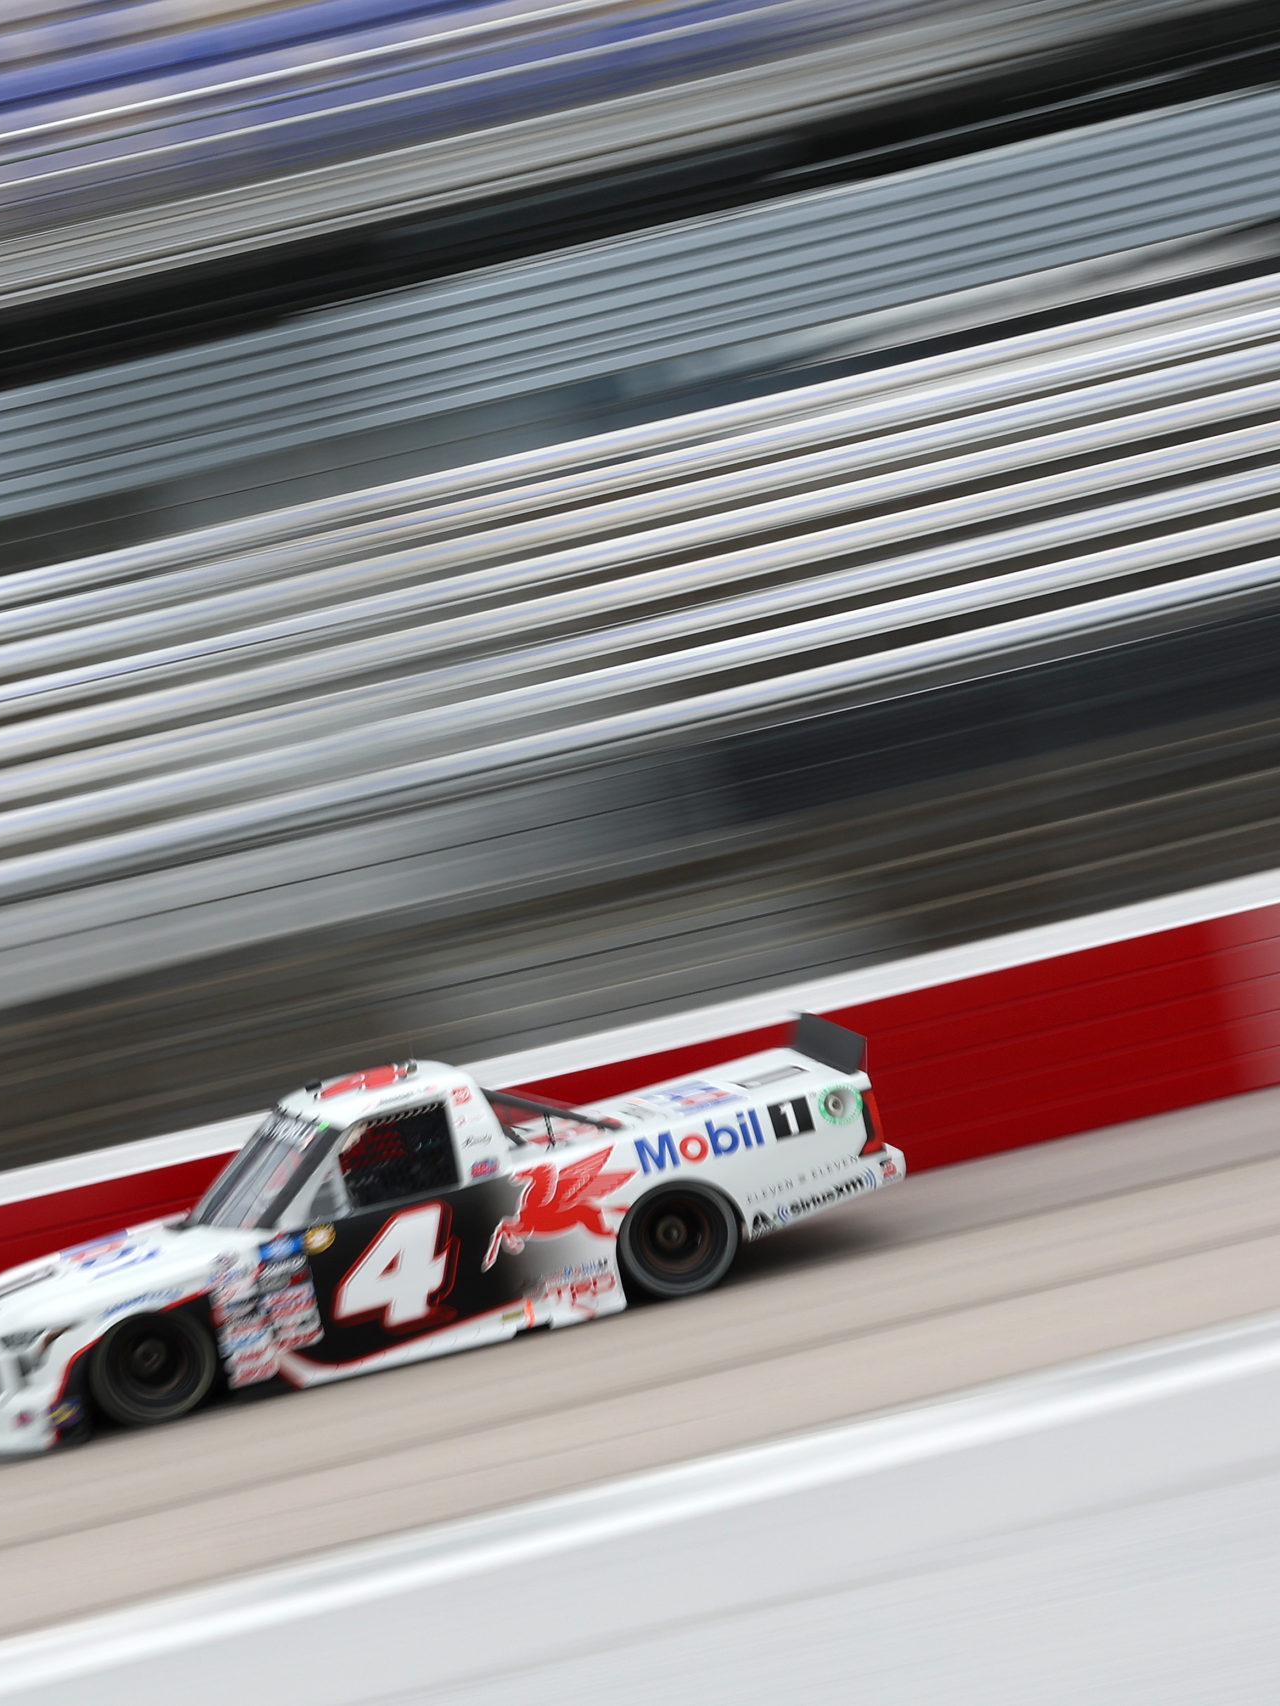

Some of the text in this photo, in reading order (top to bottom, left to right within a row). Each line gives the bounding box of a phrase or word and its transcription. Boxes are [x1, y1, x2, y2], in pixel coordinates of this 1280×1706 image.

[633, 1108, 765, 1176] Mobil
[746, 1177, 795, 1204] ELEVEN
[811, 1153, 860, 1180] ELEVEN
[334, 1200, 458, 1333] 4
